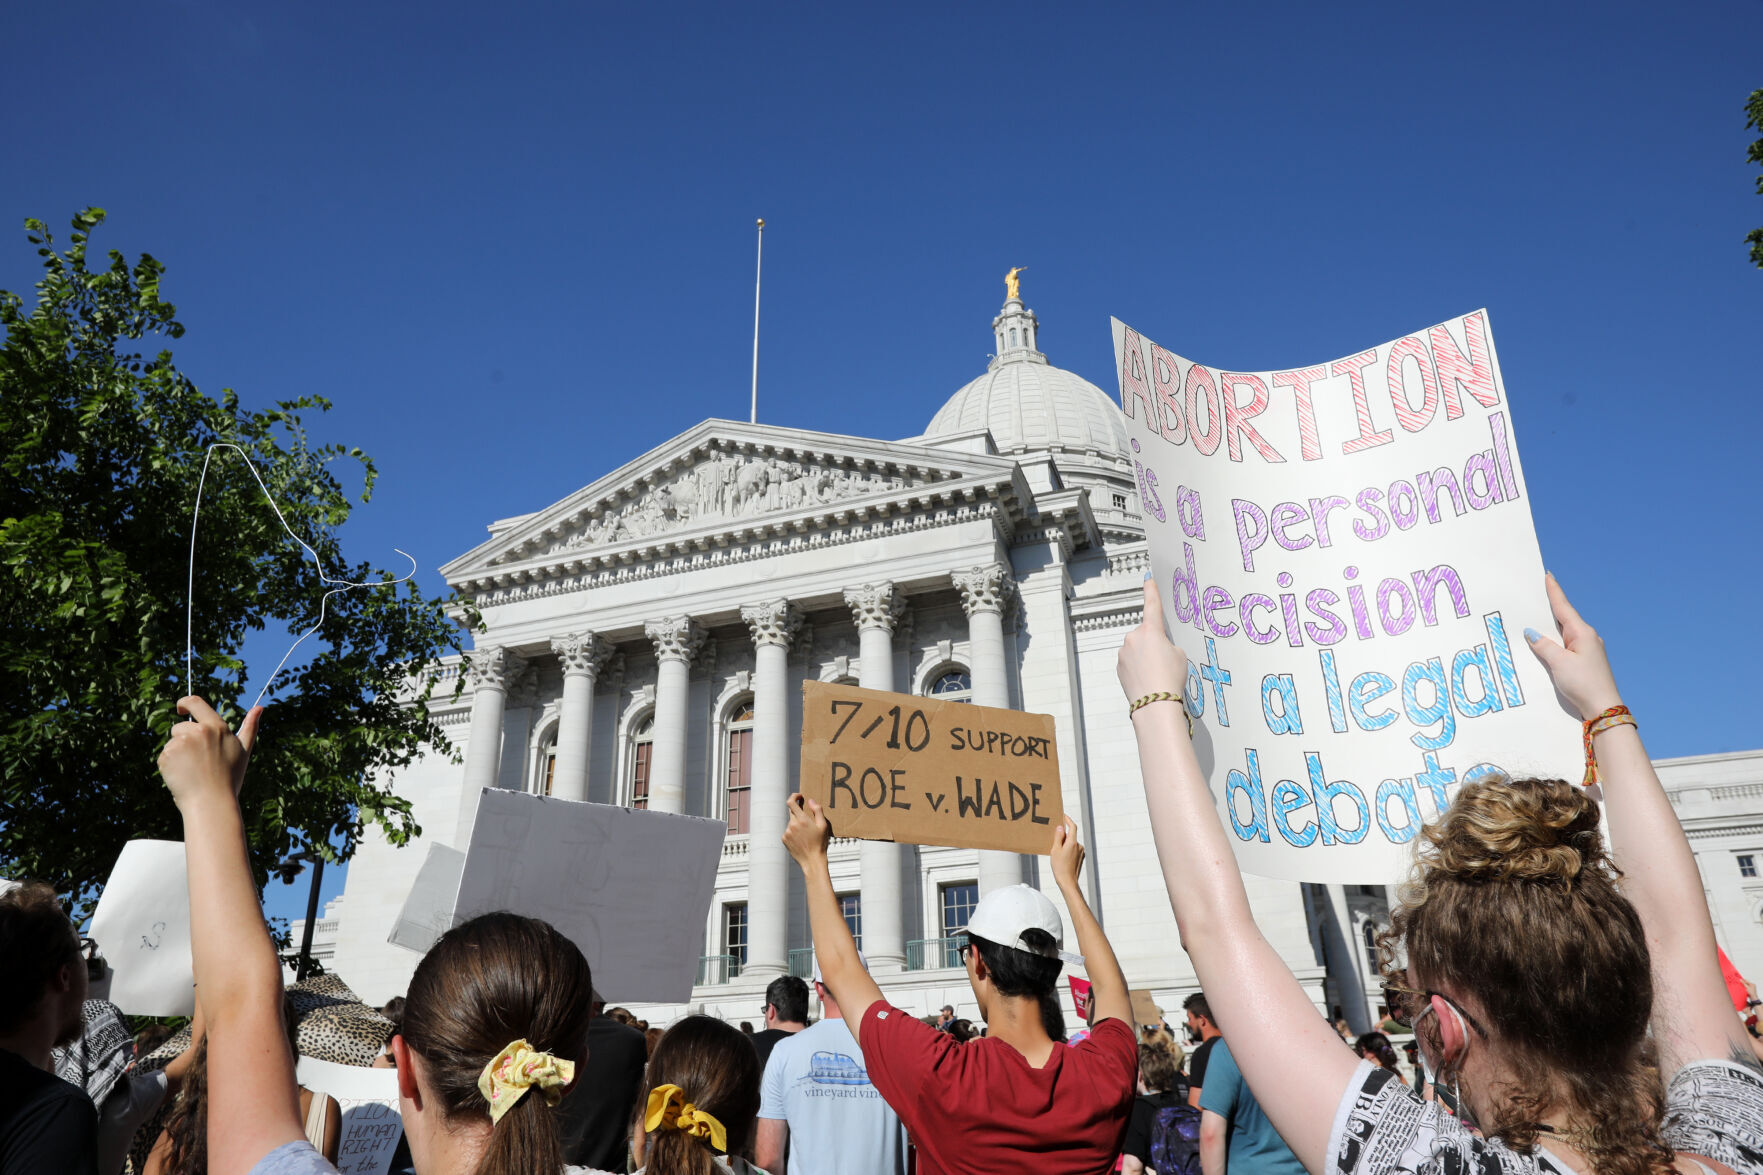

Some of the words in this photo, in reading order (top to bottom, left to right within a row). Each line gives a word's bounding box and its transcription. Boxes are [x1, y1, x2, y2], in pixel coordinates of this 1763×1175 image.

[1122, 311, 1501, 463] ABORTION
[1129, 438, 1166, 523] is
[1176, 485, 1206, 541] a
[1231, 411, 1520, 572] personal
[1172, 542, 1471, 648] decision
[1186, 635, 1232, 728] ot
[1261, 673, 1304, 735] a
[1319, 611, 1526, 751] legal
[829, 700, 931, 752] 7/10
[950, 727, 1051, 760] SUPPORT
[829, 761, 911, 810] ROE
[955, 775, 1050, 826] WADE
[1225, 748, 1512, 849] debat
[804, 1086, 857, 1100] vineyard
[859, 1088, 883, 1099] vin
[341, 1137, 394, 1155] RIGHT
[347, 1123, 397, 1139] HUMAN
[357, 1155, 378, 1172] the
